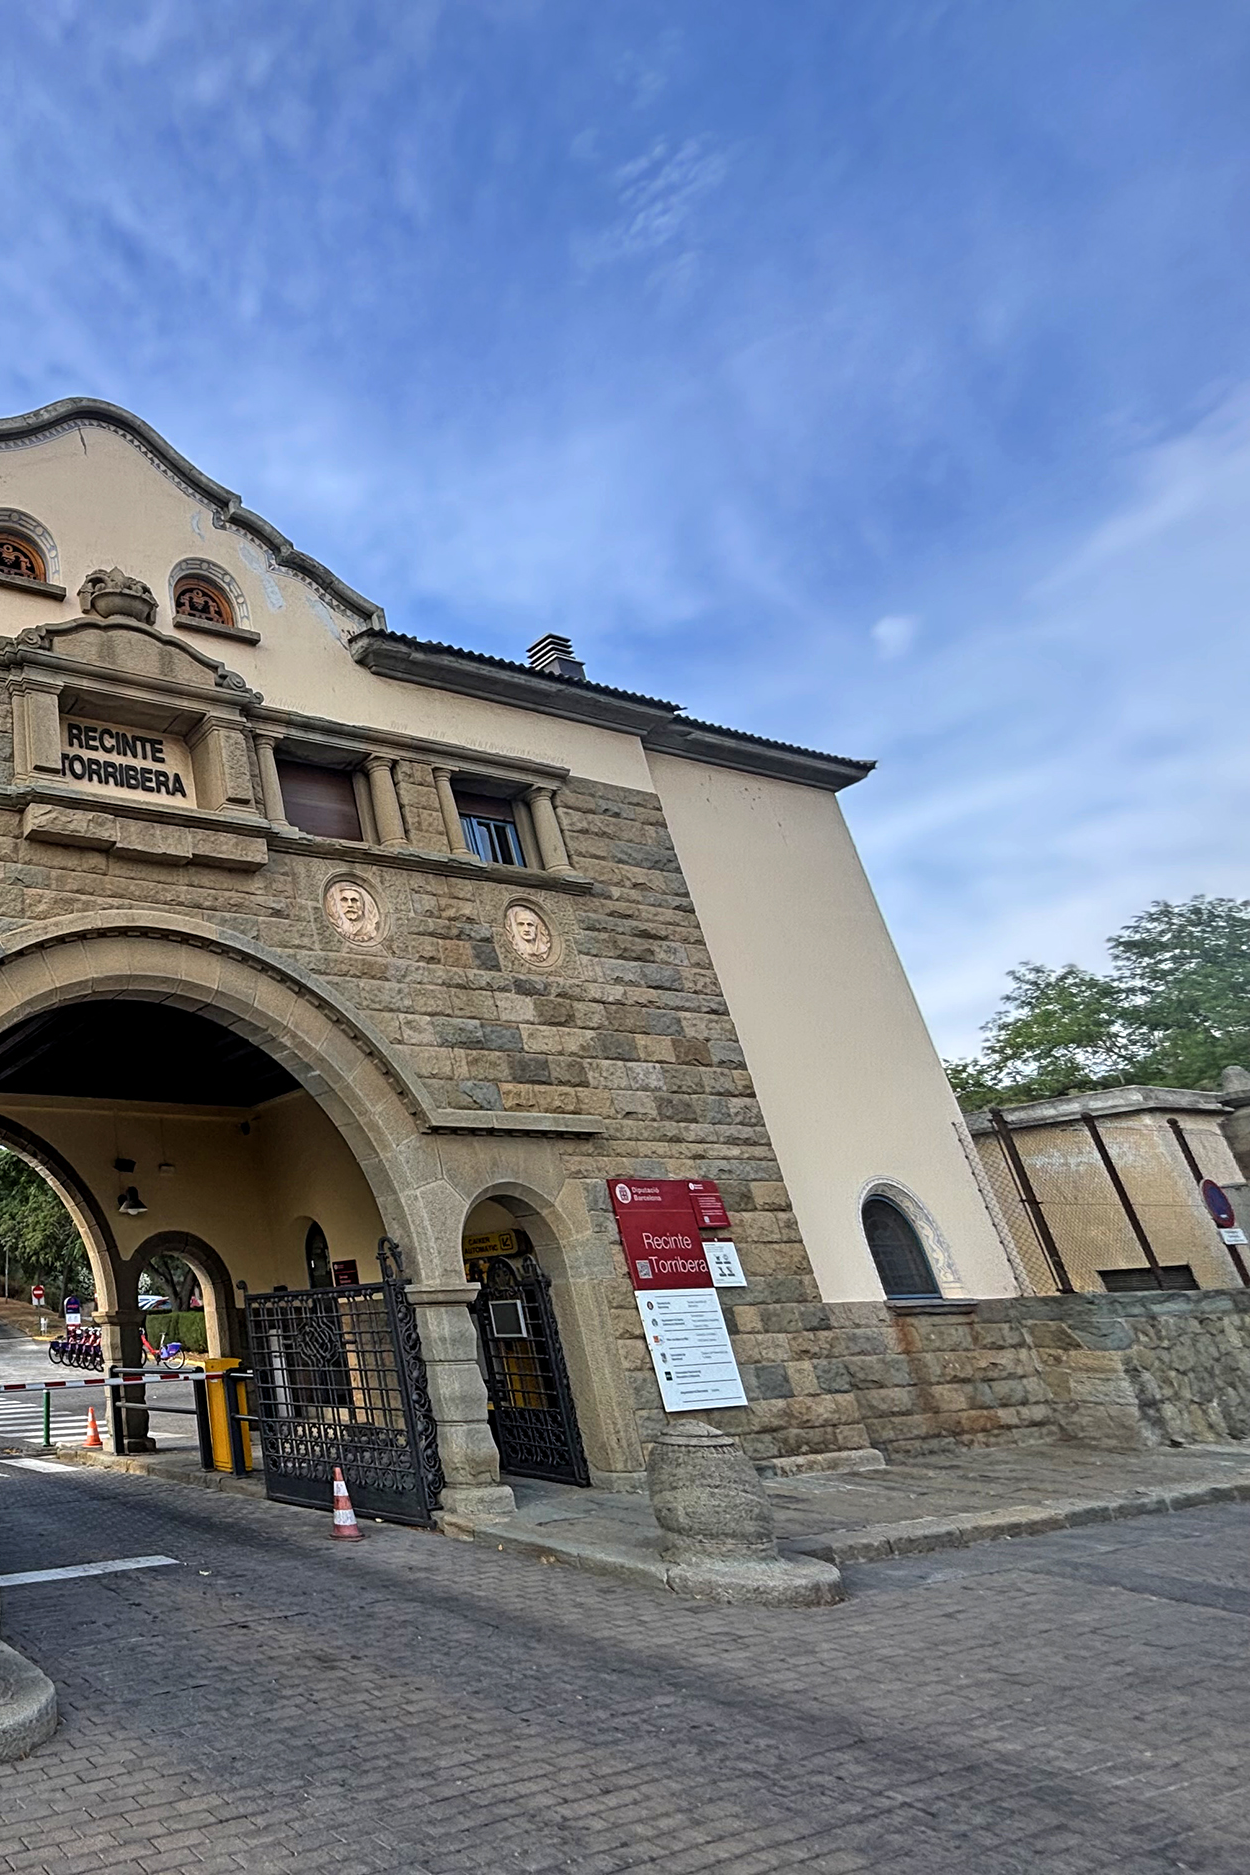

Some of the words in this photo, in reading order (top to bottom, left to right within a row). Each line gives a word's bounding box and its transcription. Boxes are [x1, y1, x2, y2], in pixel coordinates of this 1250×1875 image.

[67, 723, 166, 763] RECINTE
[61, 752, 187, 798] TORRIBERA
[642, 1232, 692, 1250] Recinte
[648, 1255, 708, 1273] Torribera
